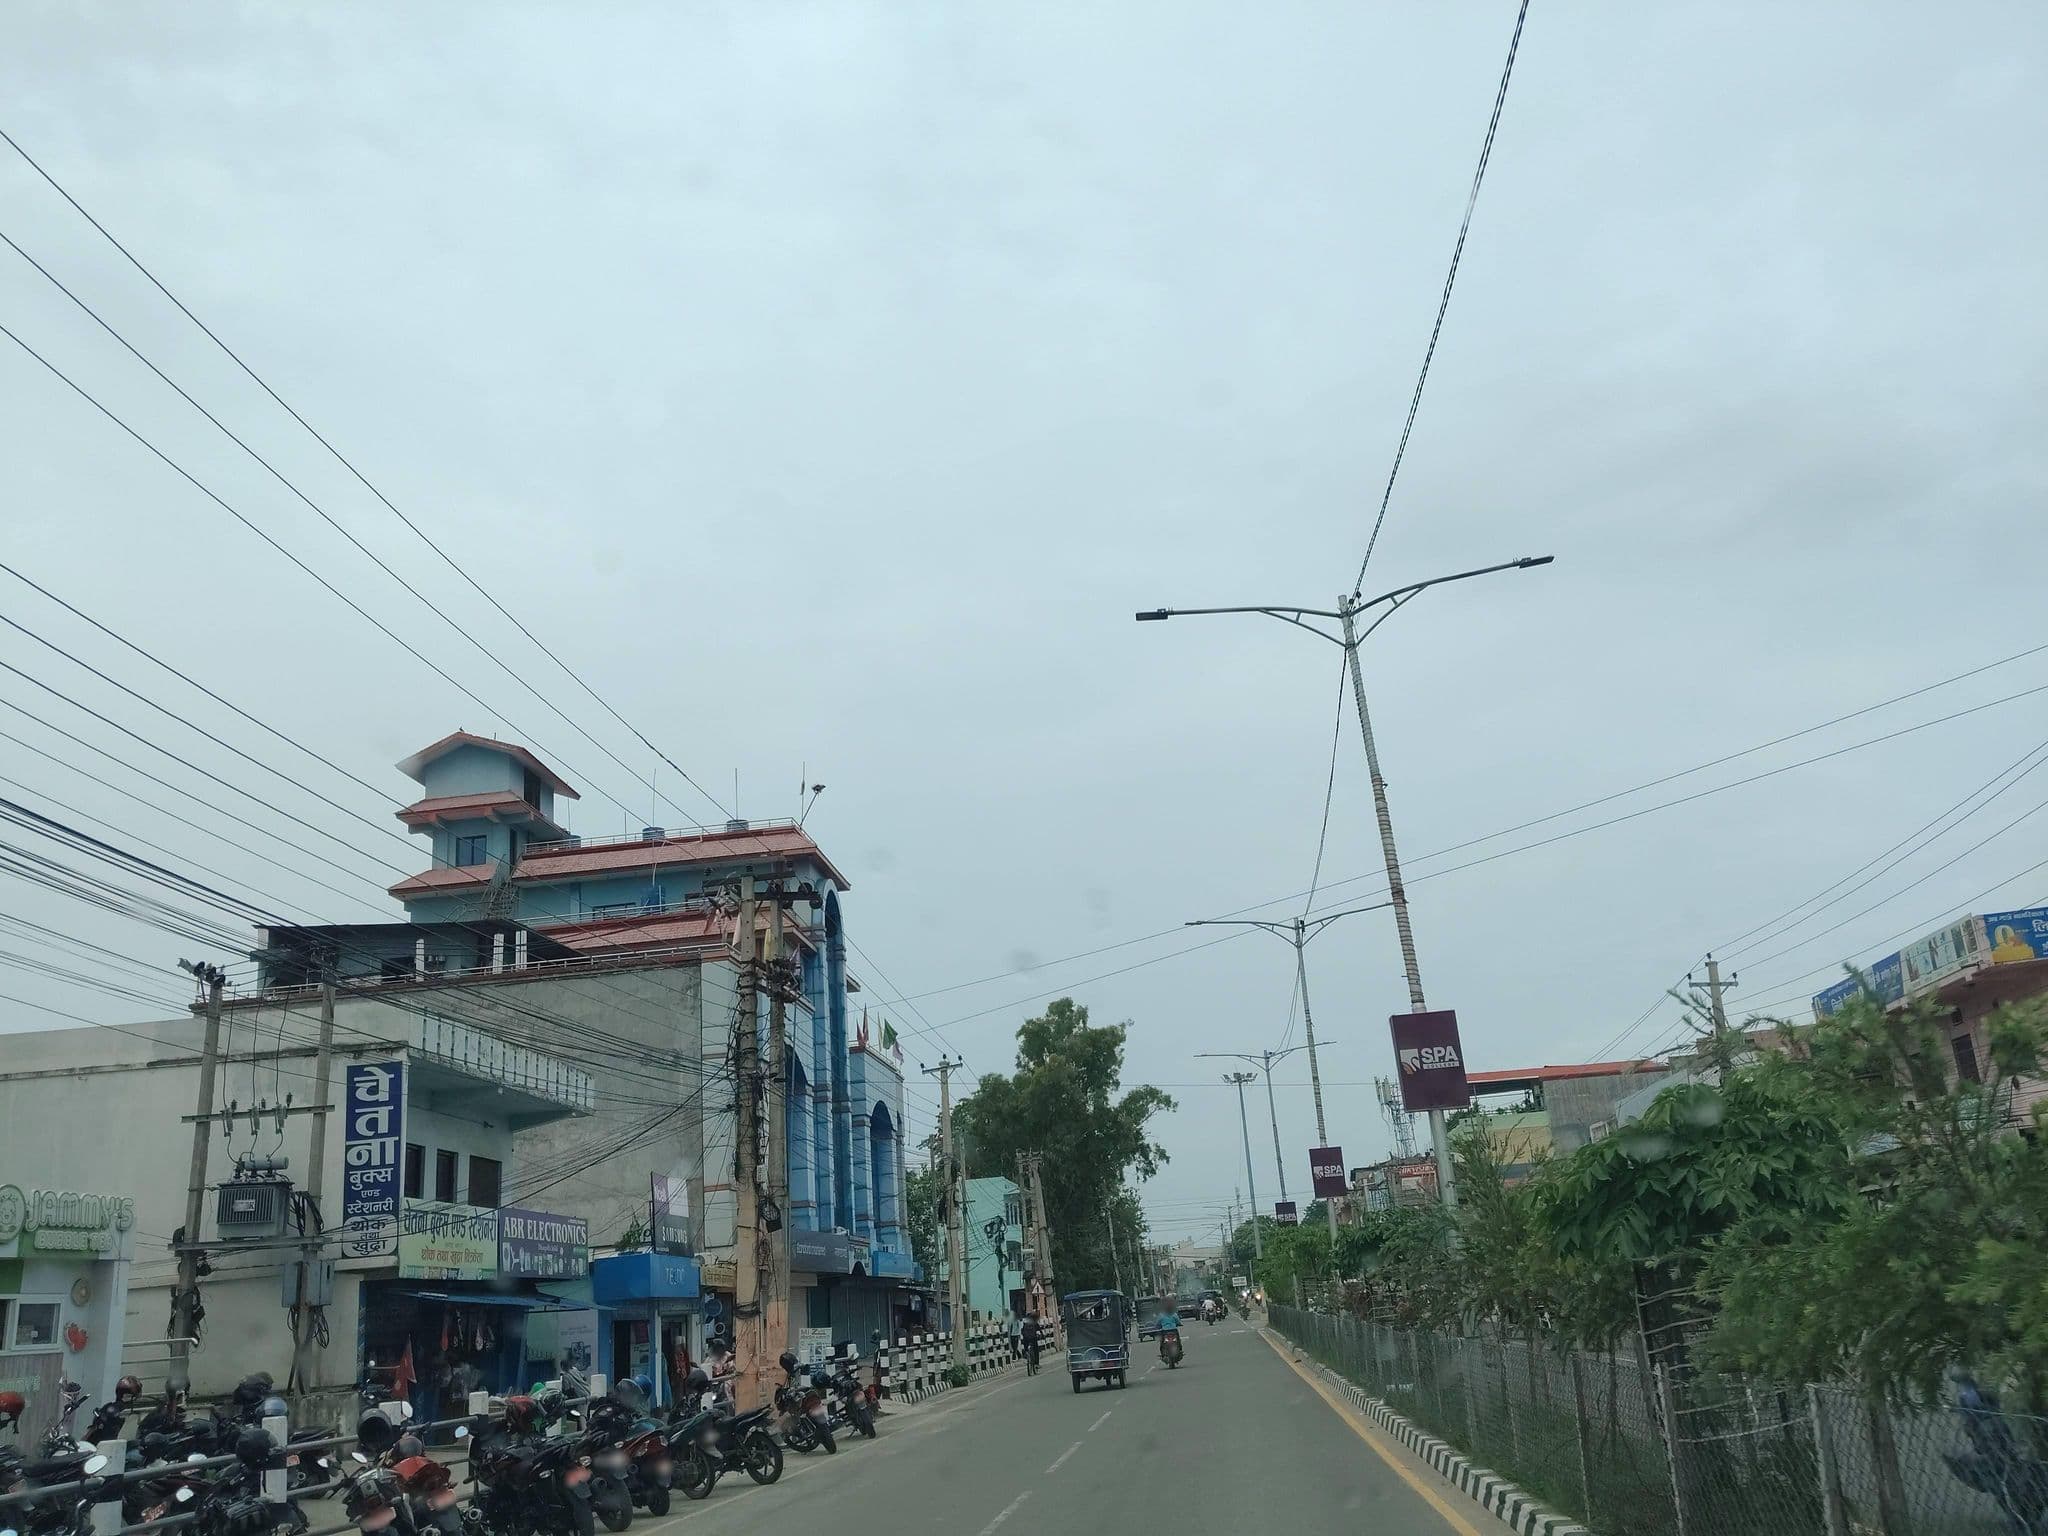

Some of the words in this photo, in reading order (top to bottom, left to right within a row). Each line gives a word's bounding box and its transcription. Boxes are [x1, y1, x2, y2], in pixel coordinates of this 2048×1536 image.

[349, 1168, 394, 1190] बुक्स
[26, 1189, 135, 1232] JAMMY'S
[347, 1197, 394, 1214] स्टेशनरी
[503, 1216, 525, 1239] ABR
[527, 1219, 587, 1245] ELECTRONICS
[662, 1226, 688, 1244] SAMSUNG
